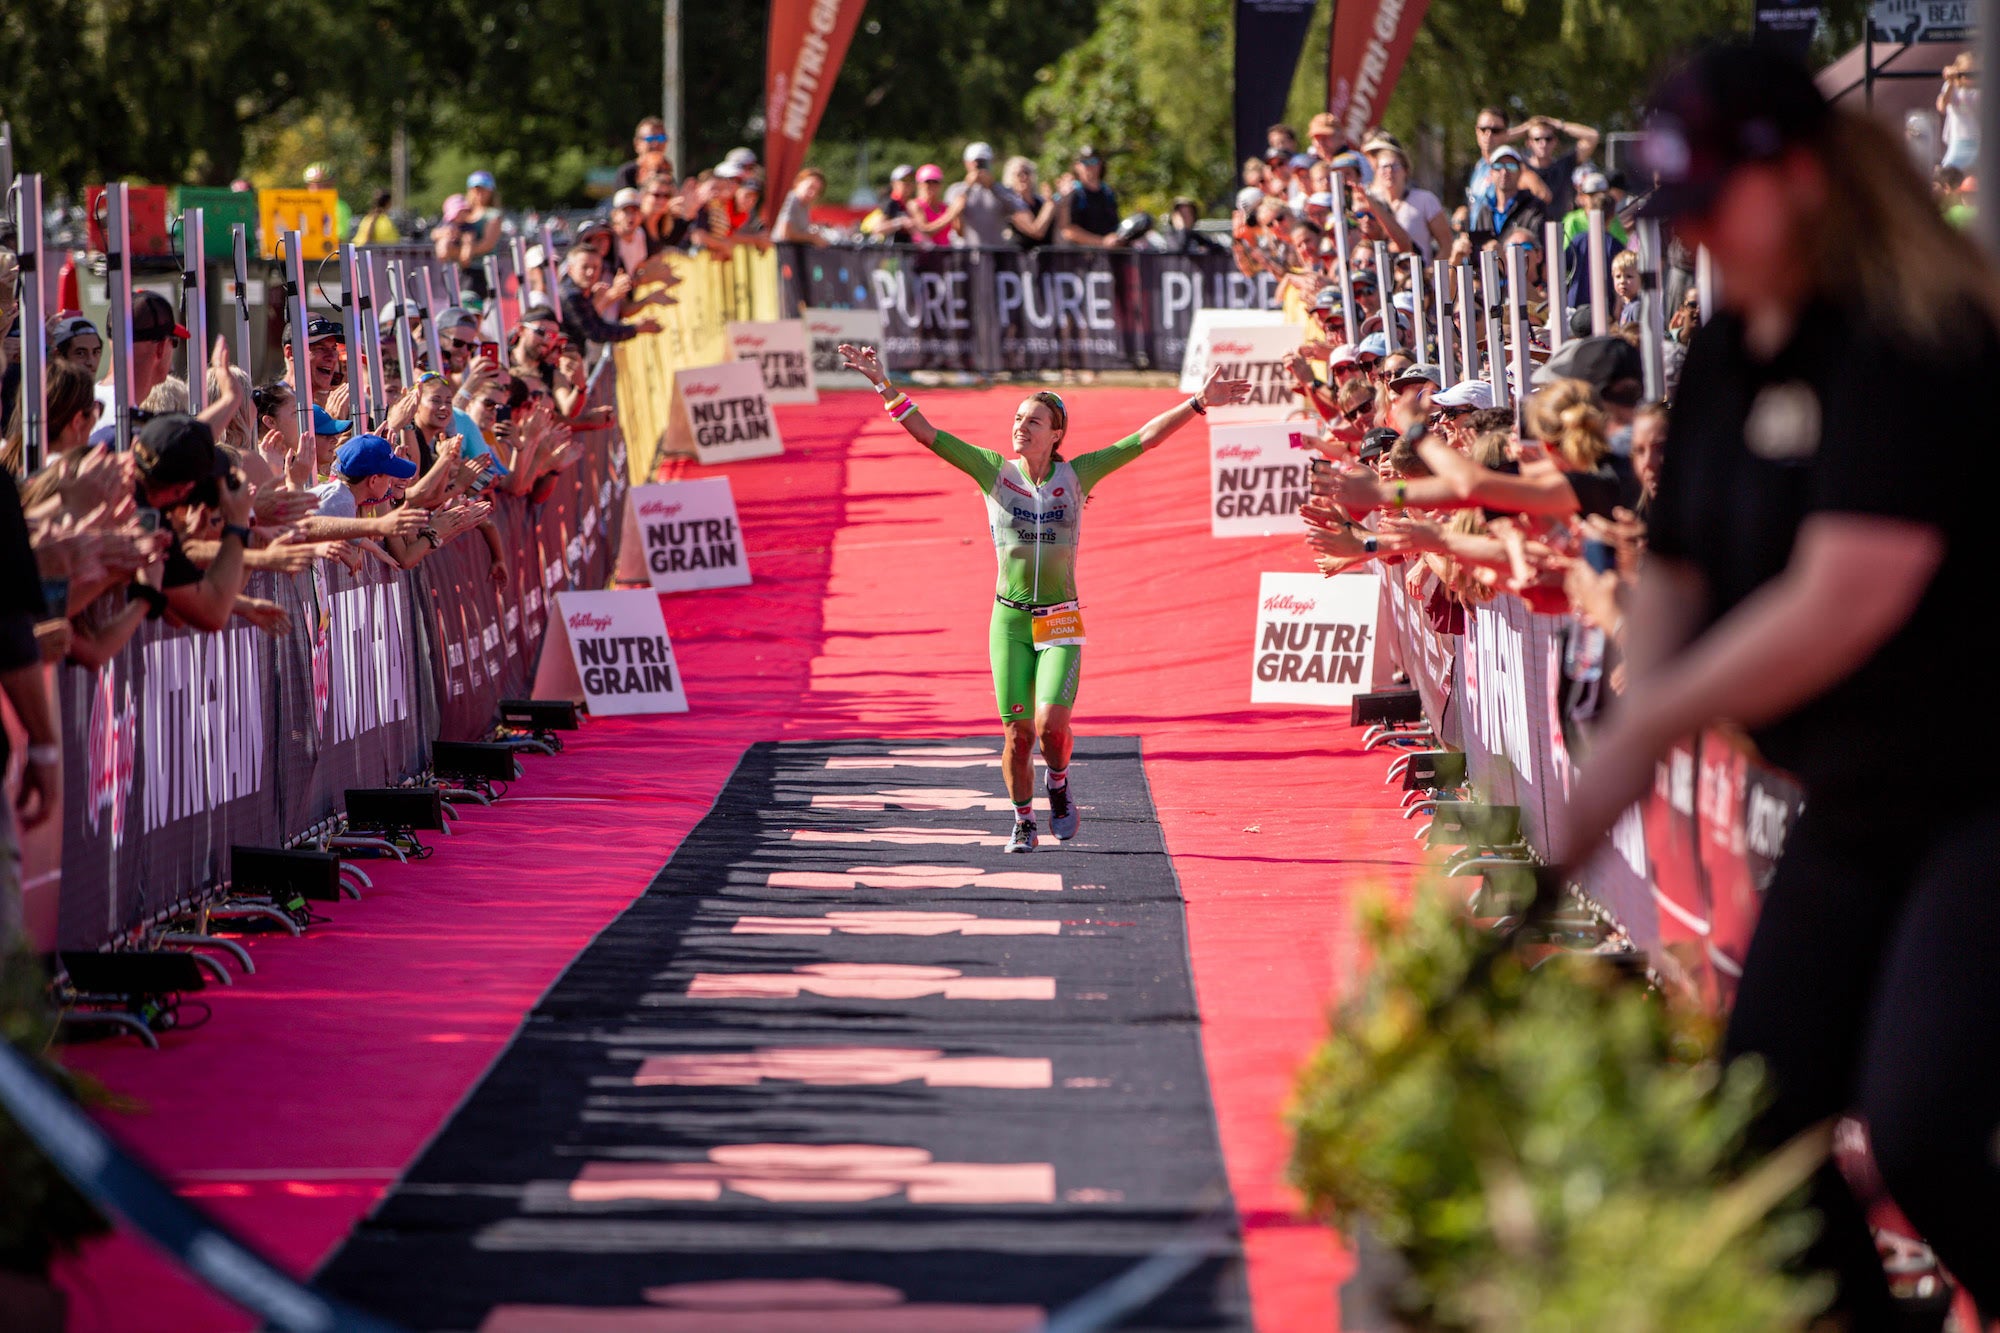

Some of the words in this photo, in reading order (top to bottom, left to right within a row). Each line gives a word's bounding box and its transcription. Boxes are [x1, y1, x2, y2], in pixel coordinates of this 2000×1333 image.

[872, 269, 970, 329] PURE
[996, 271, 1116, 330] PURE
[697, 419, 770, 447] GRAIN
[1215, 490, 1310, 519] GRAIN
[650, 543, 737, 574] GRAIN
[1263, 593, 1317, 616] Kellogg's
[568, 612, 613, 632] Kellogg's
[1045, 616, 1079, 627] TERESA
[1050, 626, 1075, 636] ADAM
[1261, 621, 1373, 653] NUTRI-
[576, 635, 670, 667] NUTRI-
[583, 664, 674, 697] GRAIN
[1256, 652, 1366, 685] GRAIN
[142, 625, 264, 836] NUTRI-GRAIN
